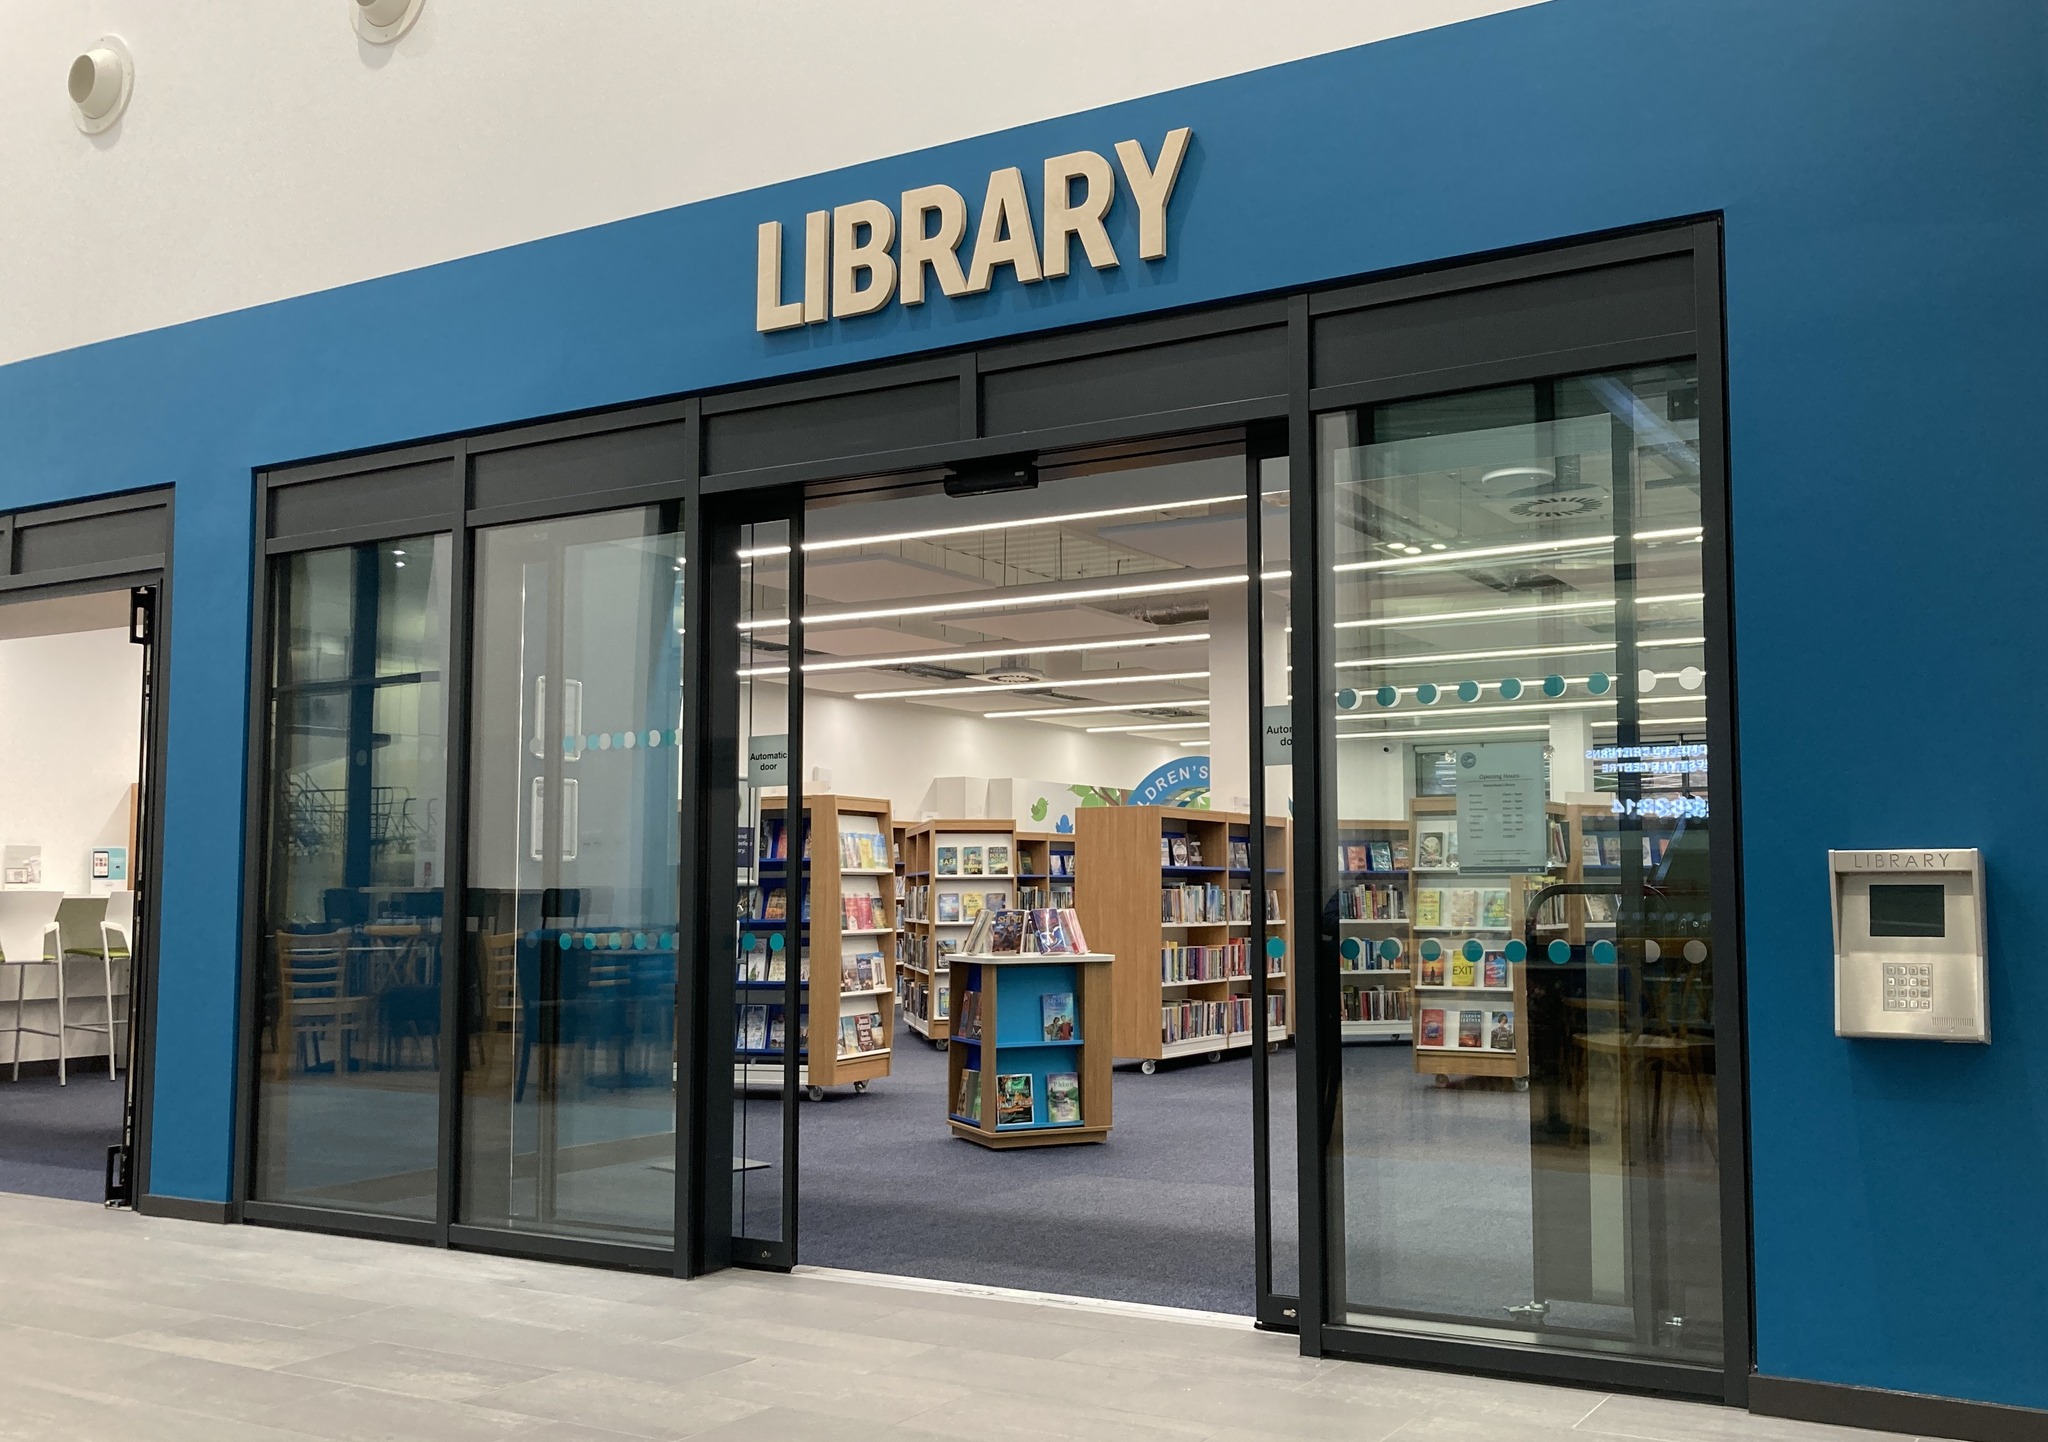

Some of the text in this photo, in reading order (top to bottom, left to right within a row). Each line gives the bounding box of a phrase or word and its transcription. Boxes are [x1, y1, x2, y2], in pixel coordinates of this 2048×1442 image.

[756, 126, 1193, 334] LIBRARY
[750, 751, 788, 762] Automatic
[760, 763, 777, 771] door
[939, 858, 957, 866] SAFE
[1854, 853, 1950, 869] LIBRARY
[1452, 965, 1474, 976] EXIT
